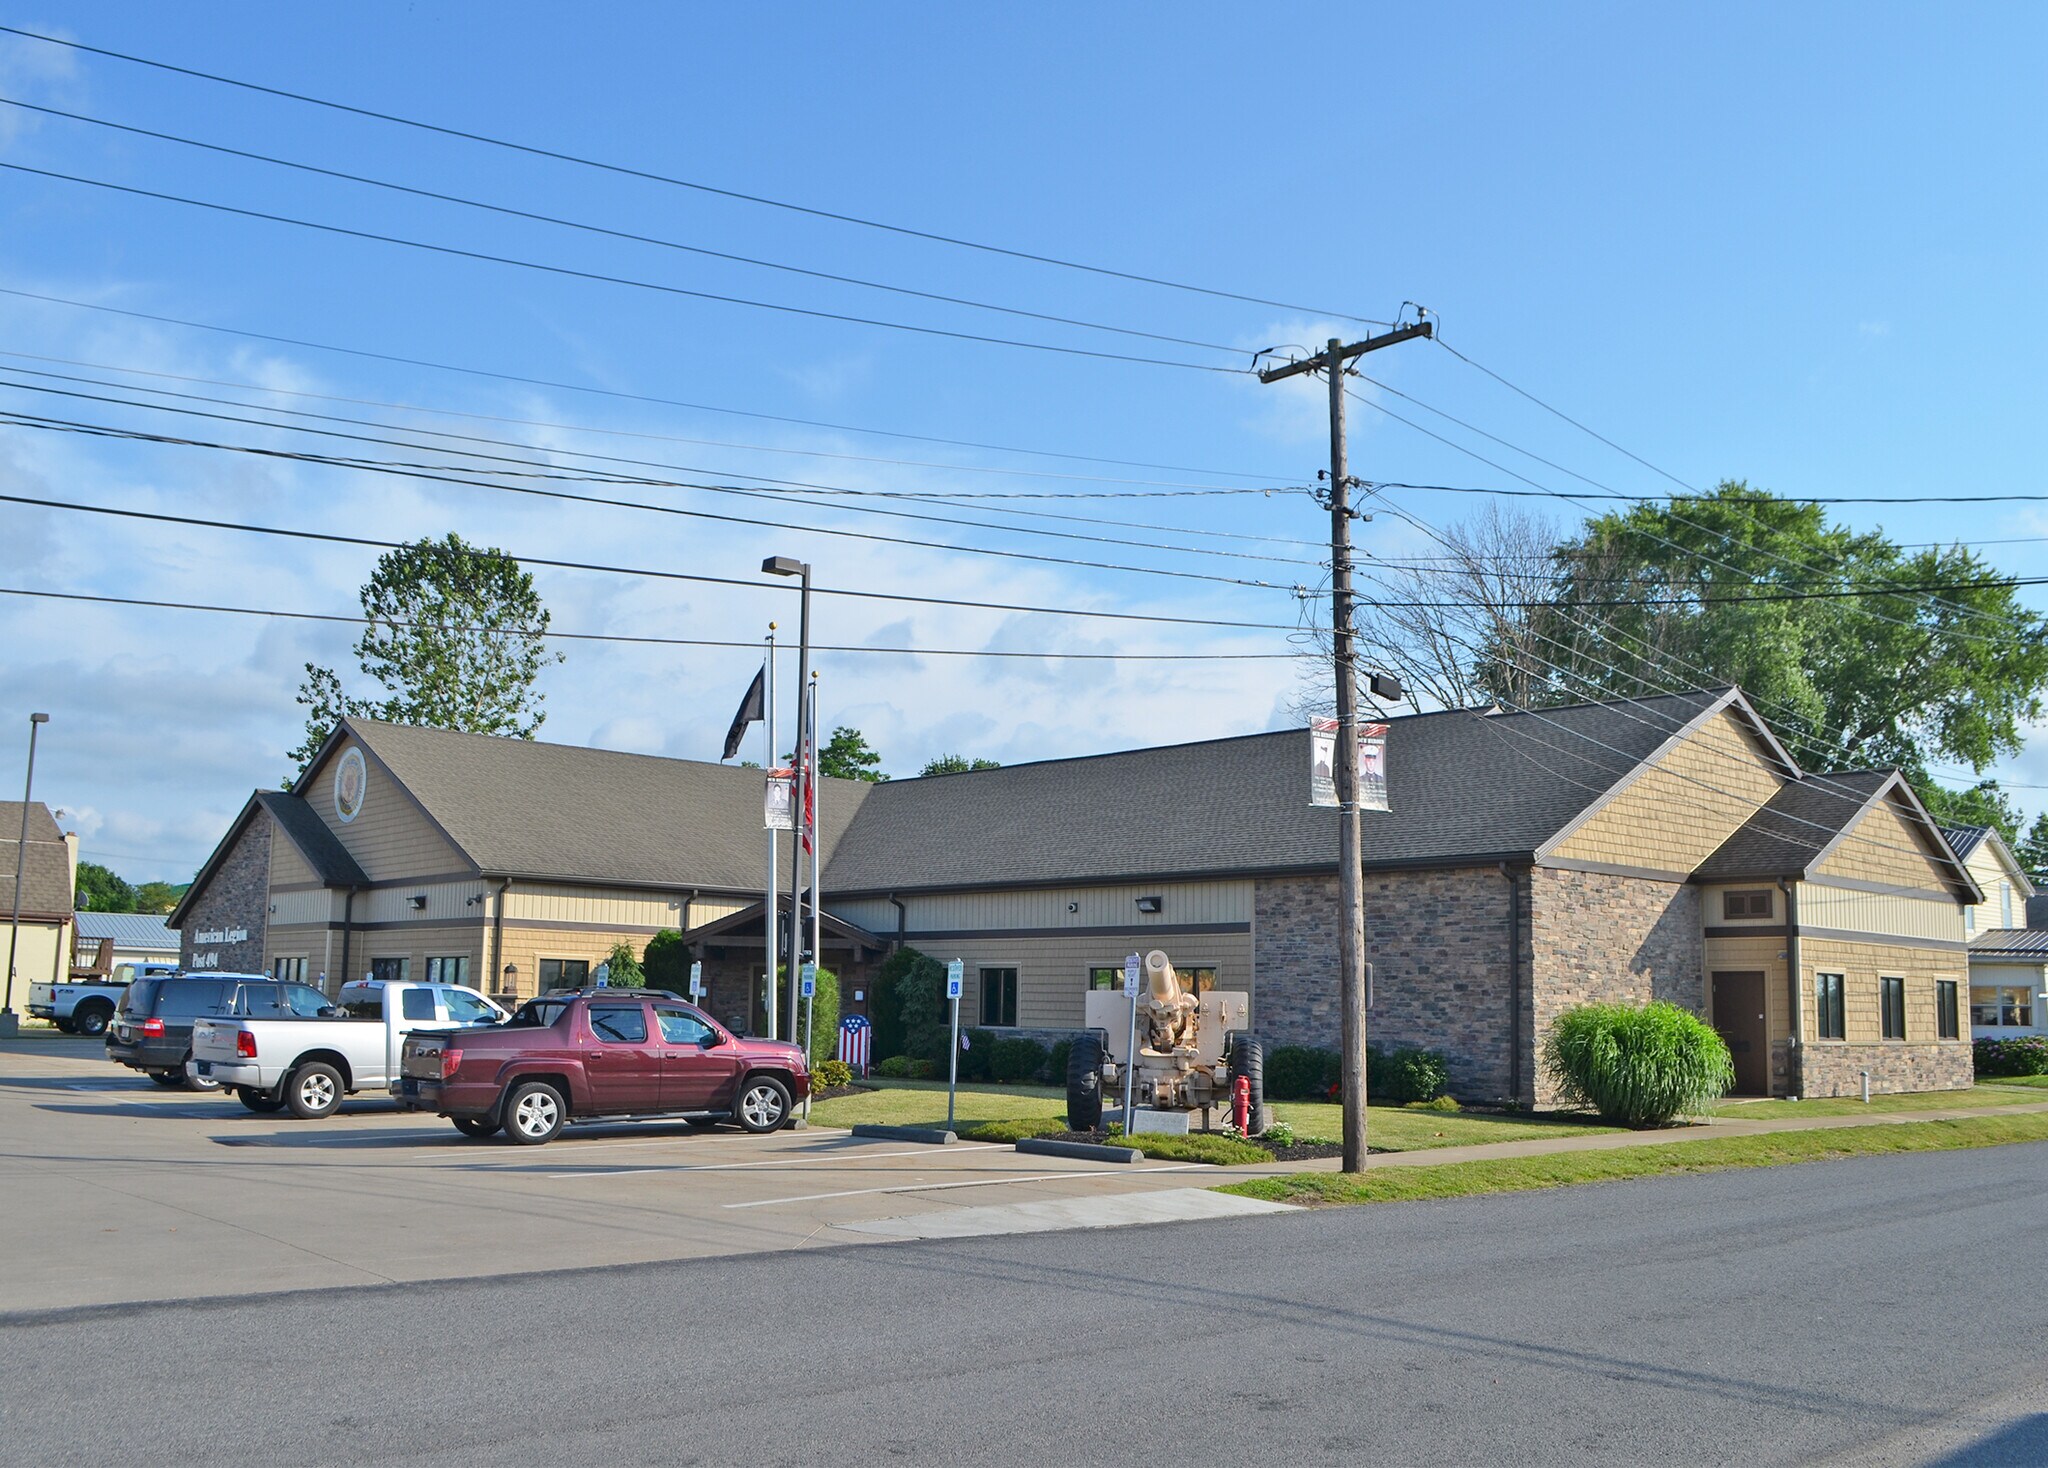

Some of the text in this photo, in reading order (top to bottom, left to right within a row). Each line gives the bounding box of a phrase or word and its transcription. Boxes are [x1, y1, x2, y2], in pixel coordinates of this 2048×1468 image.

[193, 925, 248, 945] American Legion
[192, 952, 206, 968] Post
